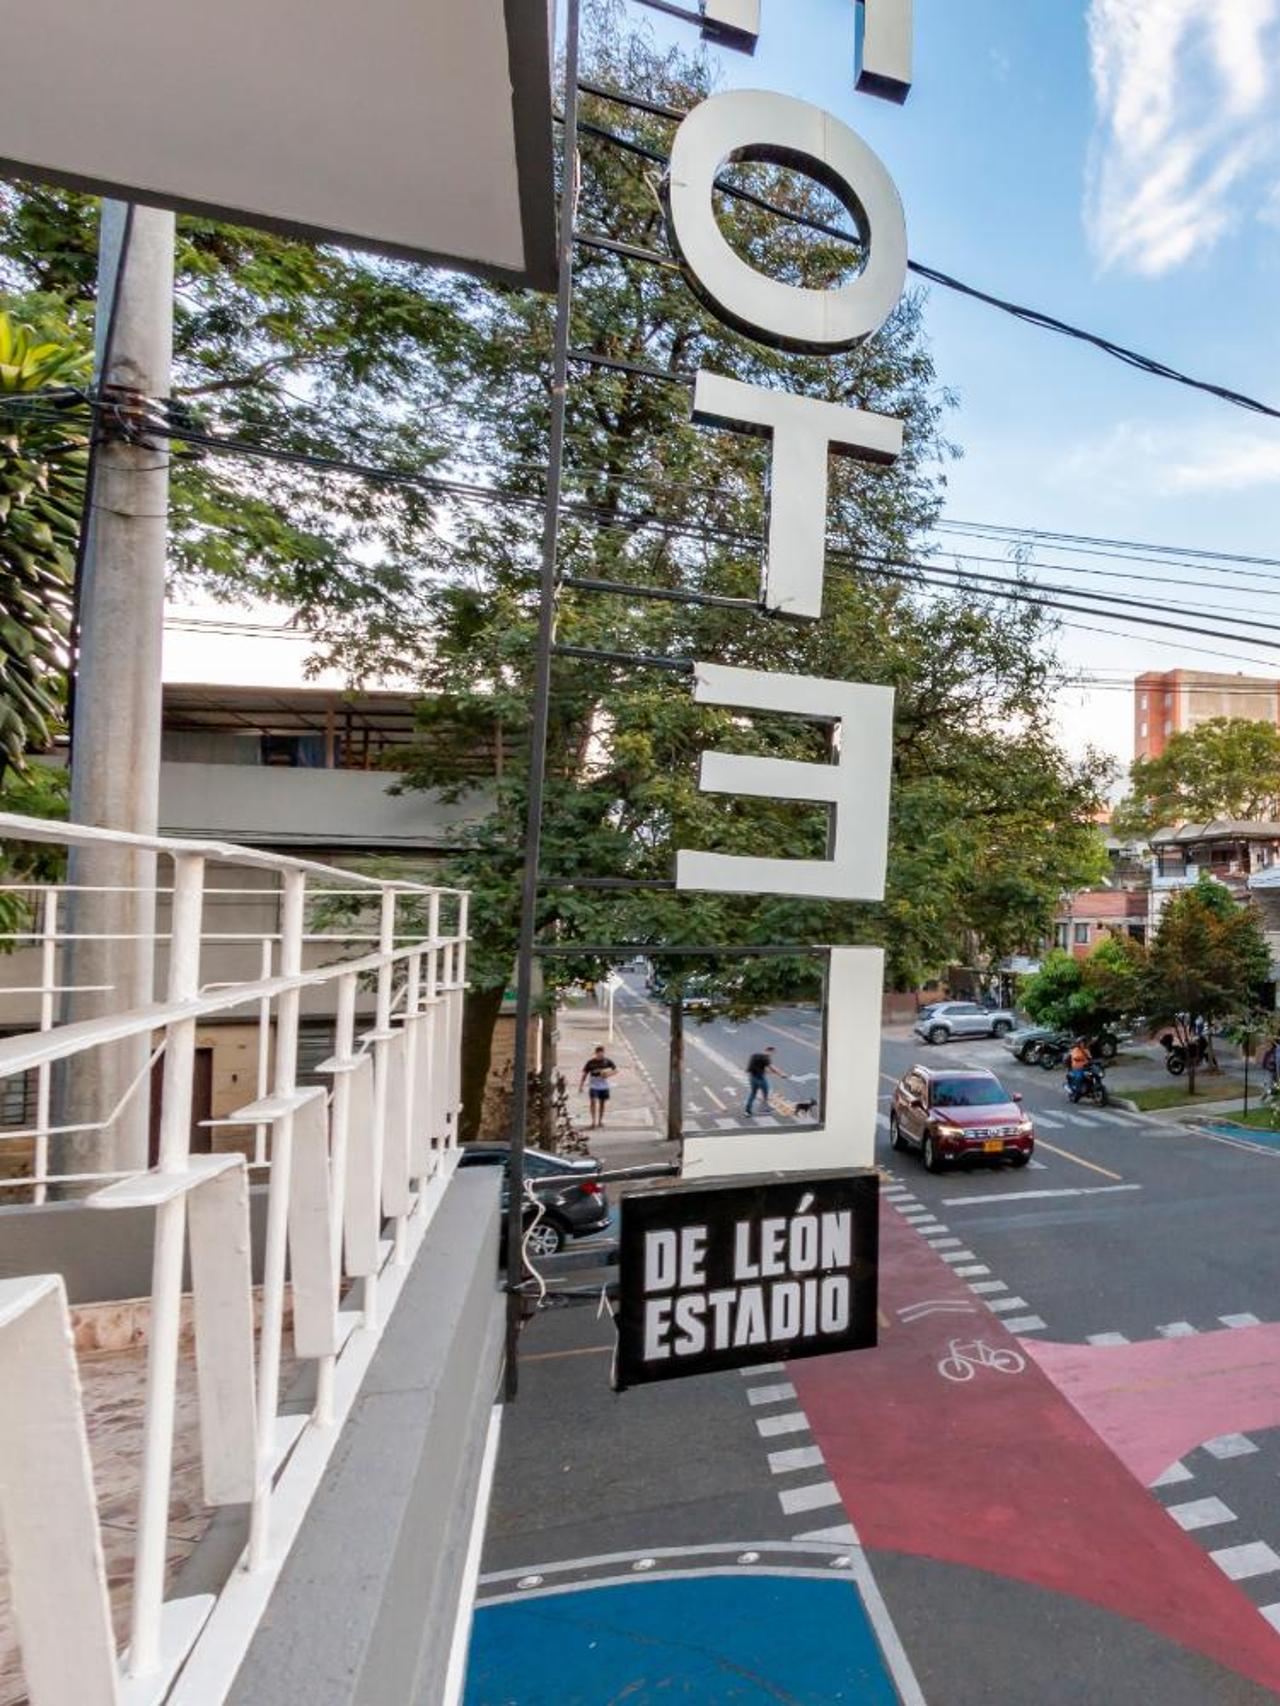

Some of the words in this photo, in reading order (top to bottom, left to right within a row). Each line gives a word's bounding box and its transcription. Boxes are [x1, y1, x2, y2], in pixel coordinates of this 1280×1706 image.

[644, 1225, 708, 1292] DE
[734, 1192, 852, 1281] LEÓN
[643, 1274, 850, 1361] ESTADIO
